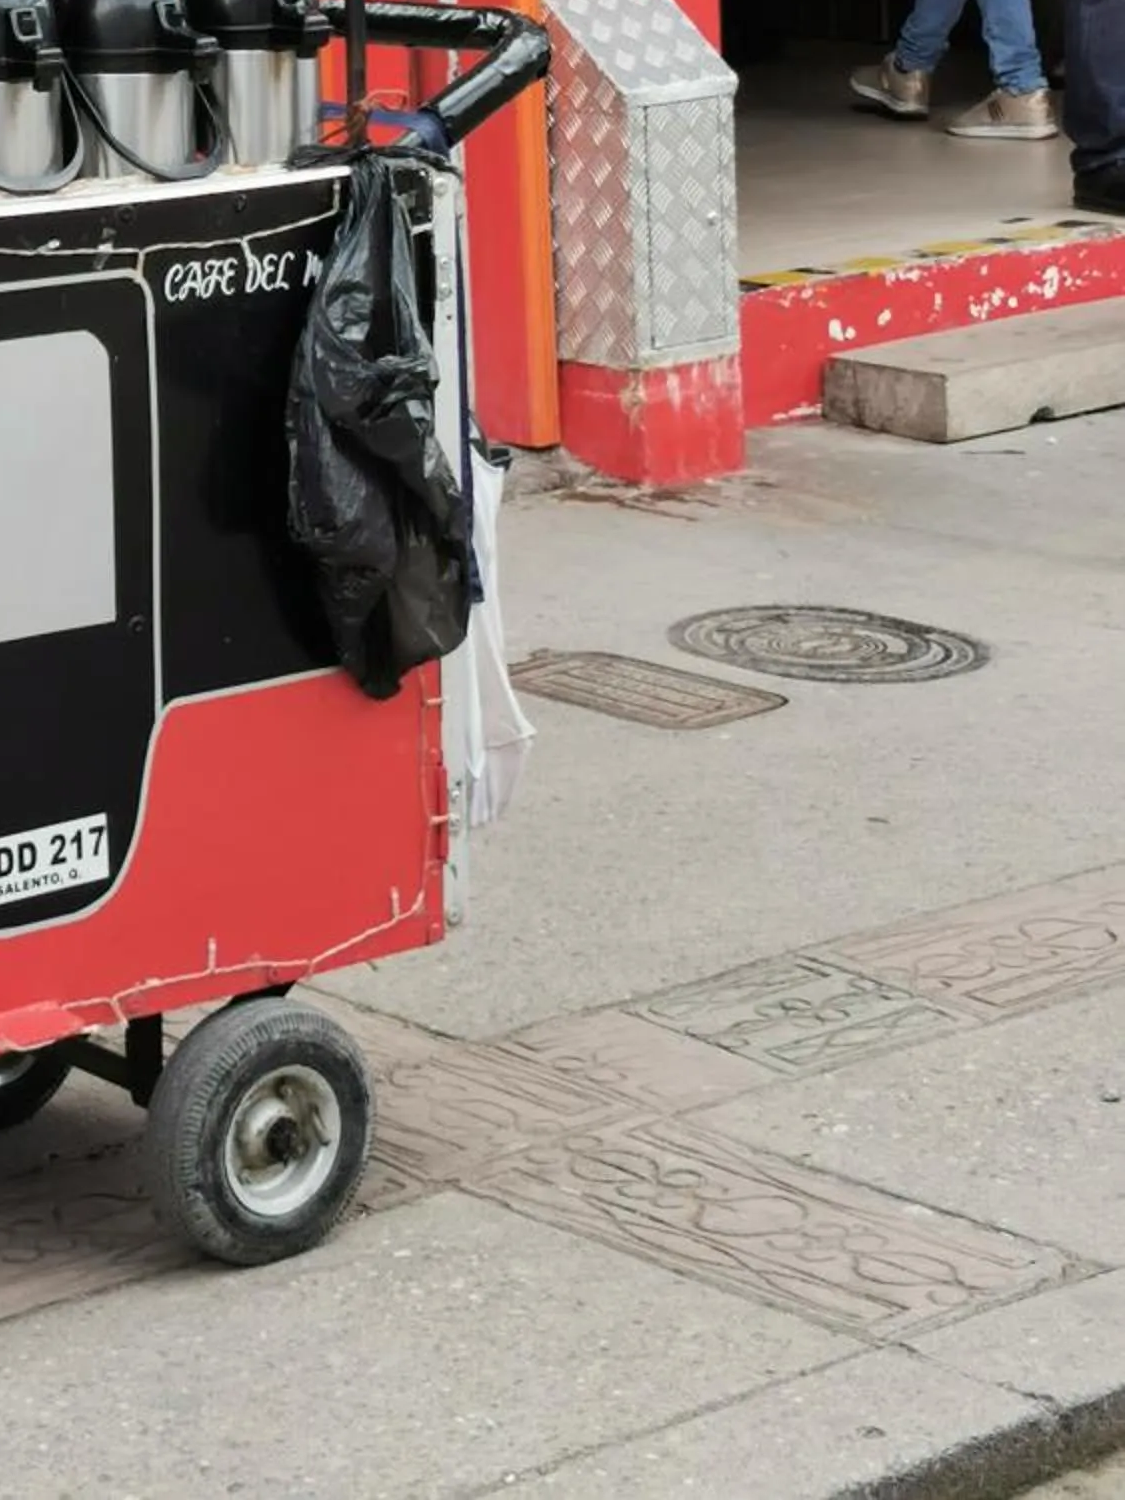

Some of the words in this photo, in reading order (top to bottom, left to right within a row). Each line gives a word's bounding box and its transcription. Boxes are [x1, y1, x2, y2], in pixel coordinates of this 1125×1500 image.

[164, 257, 238, 302] CAFE
[245, 252, 295, 293] DEL
[50, 825, 105, 866] 217
